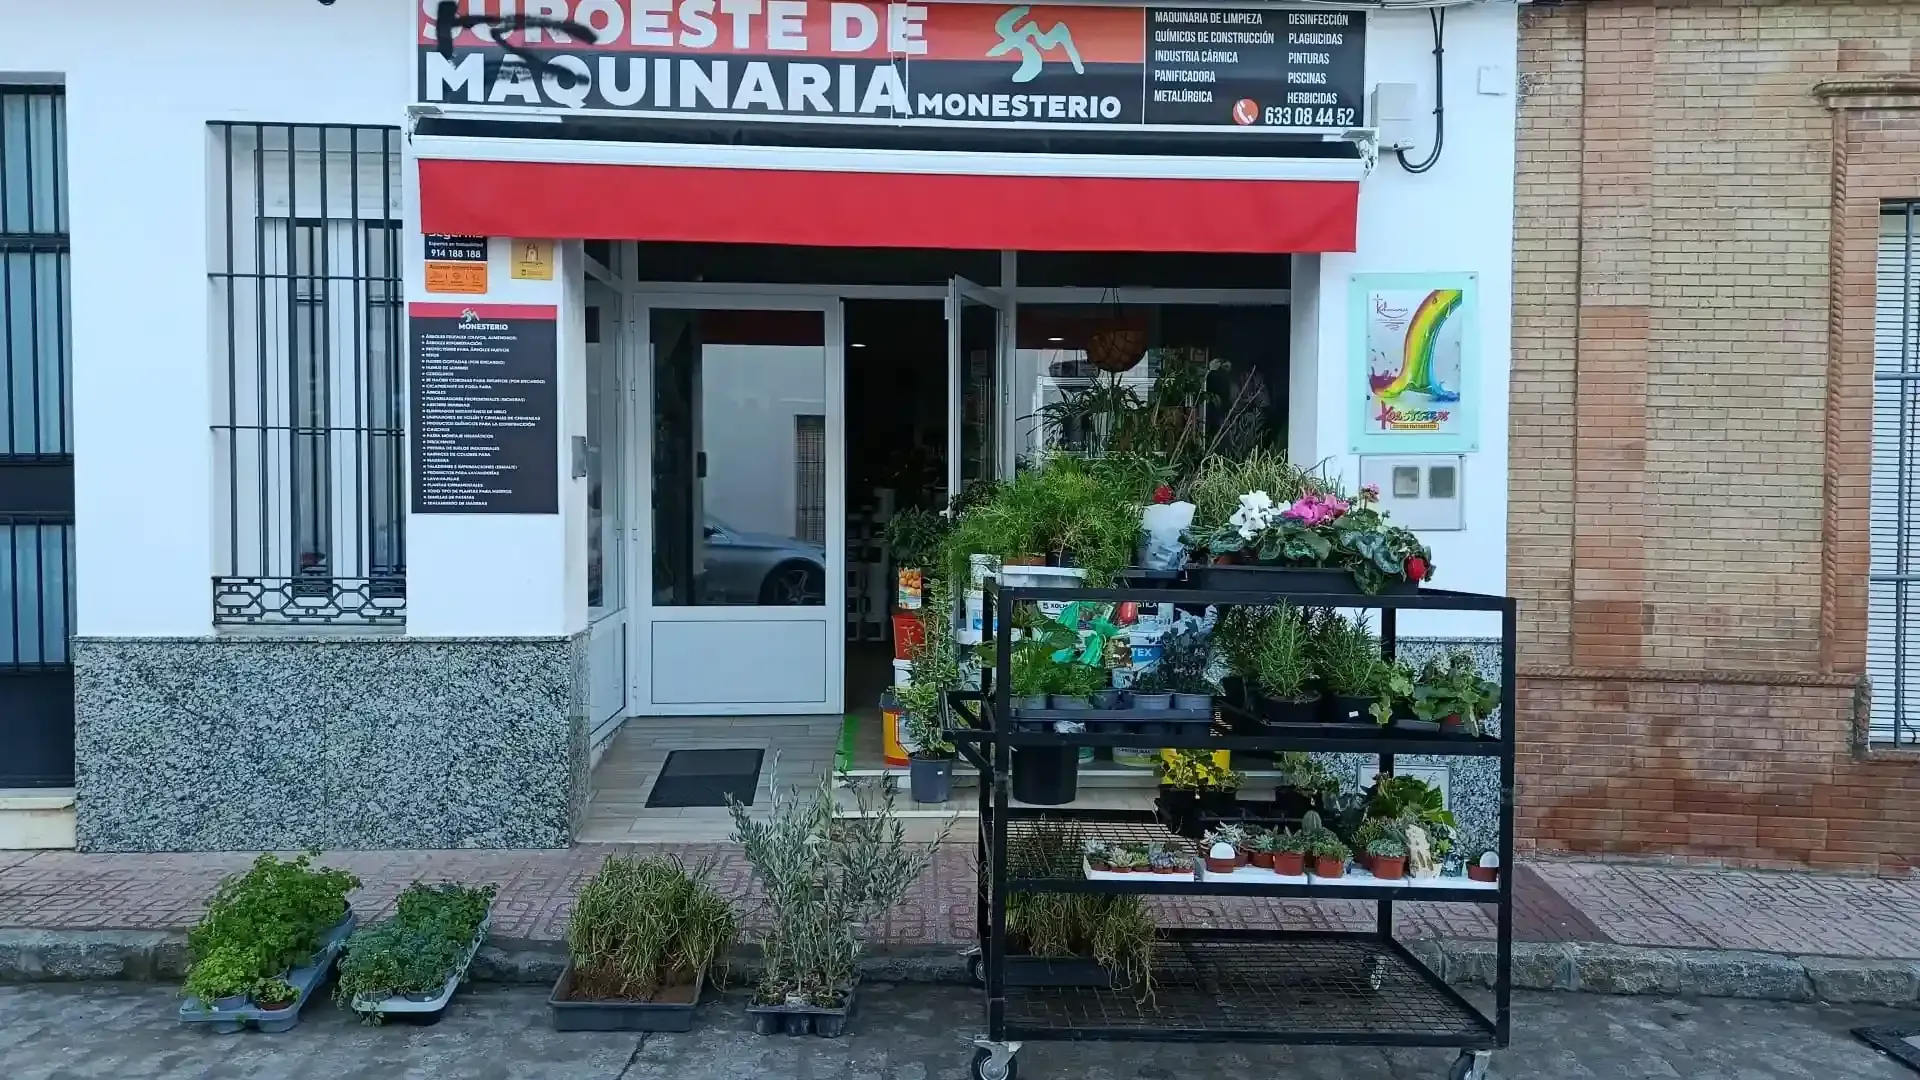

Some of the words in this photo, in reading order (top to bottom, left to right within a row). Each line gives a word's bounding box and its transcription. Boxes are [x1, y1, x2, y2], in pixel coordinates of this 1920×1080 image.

[1155, 11, 1208, 24] MAQUINARIA
[1210, 13, 1222, 24] DE
[1223, 13, 1263, 25] LIMPIEZA
[1288, 12, 1349, 26] DESINFECCIÓN
[422, 0, 808, 51] SUROESTE
[830, 2, 928, 55] DE
[1155, 28, 1196, 43] QUÍMICOS
[1197, 32, 1209, 43] DE
[1210, 31, 1275, 45] CONSTRUCCIÓN
[1288, 33, 1343, 45] PLAGUICIDAS
[1155, 50, 1200, 63] INDUSTRIA
[1201, 49, 1239, 63] CÁRNICA
[1288, 52, 1330, 65] PINTURAS
[1154, 70, 1216, 83] PANIFICADORA
[1287, 72, 1327, 84] PISCINAS
[425, 51, 912, 114] MAQUINARIA
[917, 93, 1121, 119] MONESTERIO
[1154, 88, 1213, 103] METALÚRGICA
[1287, 92, 1338, 105] HERBICIDAS
[1264, 107, 1292, 125] 633
[1294, 107, 1313, 125] 08
[1315, 107, 1334, 125] 44
[1336, 108, 1355, 126] 52
[431, 249, 446, 257] 914
[449, 250, 464, 258] 188
[466, 250, 481, 258] 188
[458, 323, 509, 331] MONESTERIO
